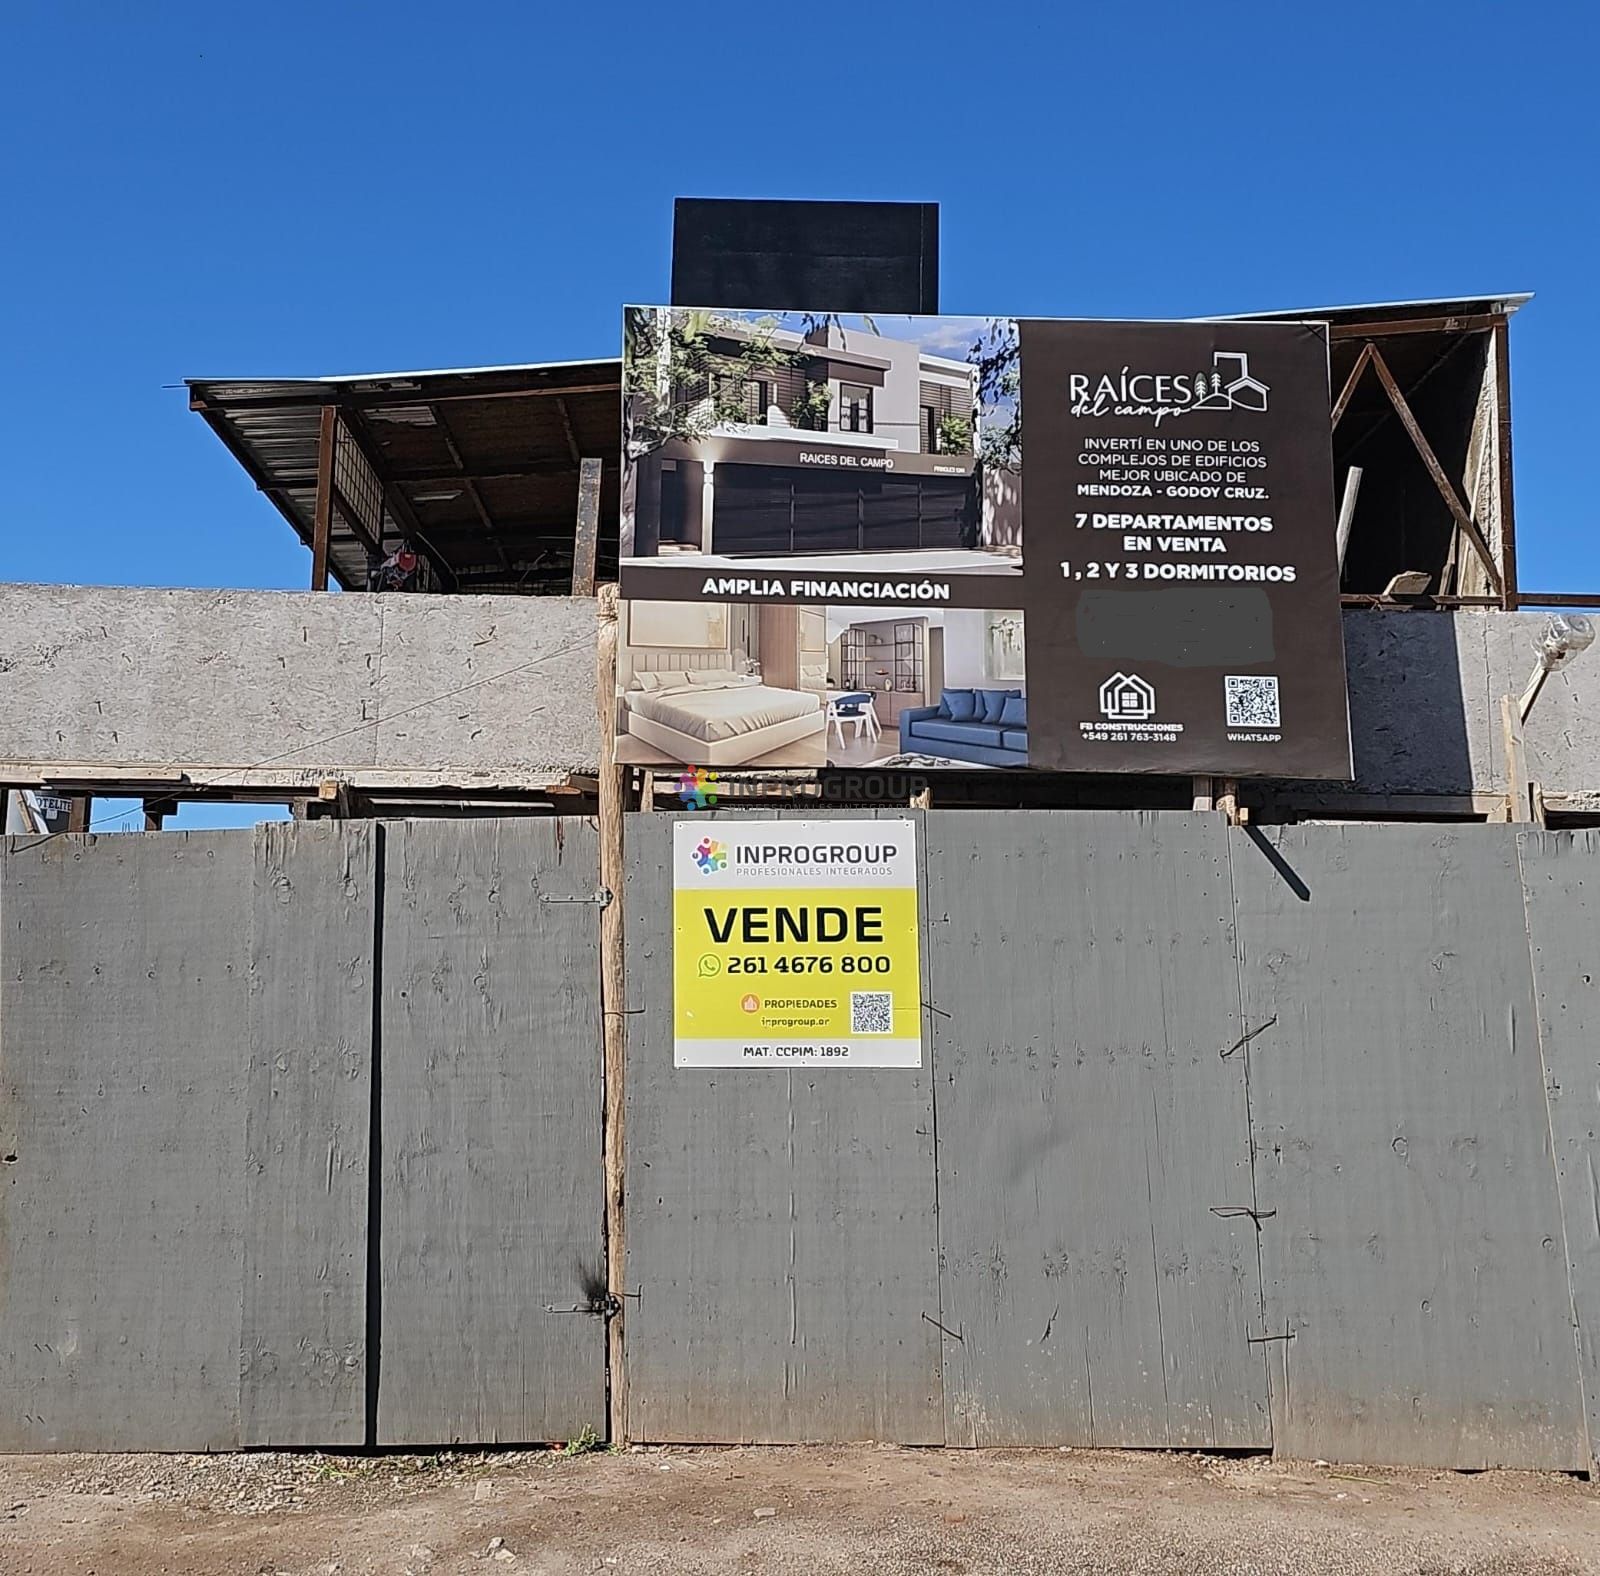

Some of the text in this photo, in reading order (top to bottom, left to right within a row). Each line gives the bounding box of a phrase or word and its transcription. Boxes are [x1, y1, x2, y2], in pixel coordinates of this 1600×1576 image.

[1069, 366, 1192, 404] RAÍCES
[1070, 392, 1191, 428] del campo
[1084, 437, 1260, 453] INVERTÍ EN UNO DE LOS
[800, 452, 894, 470] RAICES DEL CAMPO
[1078, 453, 1267, 468] COMPLEJOS DE EDIFICIOS
[1099, 469, 1247, 483] MEJOR UBICADO DE
[1077, 484, 1153, 498] MENDOZA
[1166, 486, 1219, 499] GODOY
[1224, 487, 1270, 500] CRUZ.
[1075, 513, 1274, 533] 7 DEPARTAMENTOS
[1123, 535, 1227, 552] EN VENTA
[1086, 563, 1100, 579] 2
[1105, 563, 1120, 579] Y
[1125, 563, 1139, 580] 3
[1143, 563, 1297, 583] DORMITORIOS
[701, 578, 951, 600] AMPLIA FINANCIACIÓN
[1094, 722, 1184, 732] CONSTRUCCIONES
[1082, 732, 1177, 742] +549 261 763-3148
[1227, 733, 1282, 743] WHATSAPP
[736, 844, 898, 865] INPROGROUP
[736, 868, 893, 876] PROFESIONALES INTEGRADOS
[704, 907, 884, 943] VENDE
[727, 956, 891, 974] 261 4676 800
[764, 999, 838, 1009] PROPIEDADES
[743, 1046, 850, 1058] MAT. CCPIM: 1892
